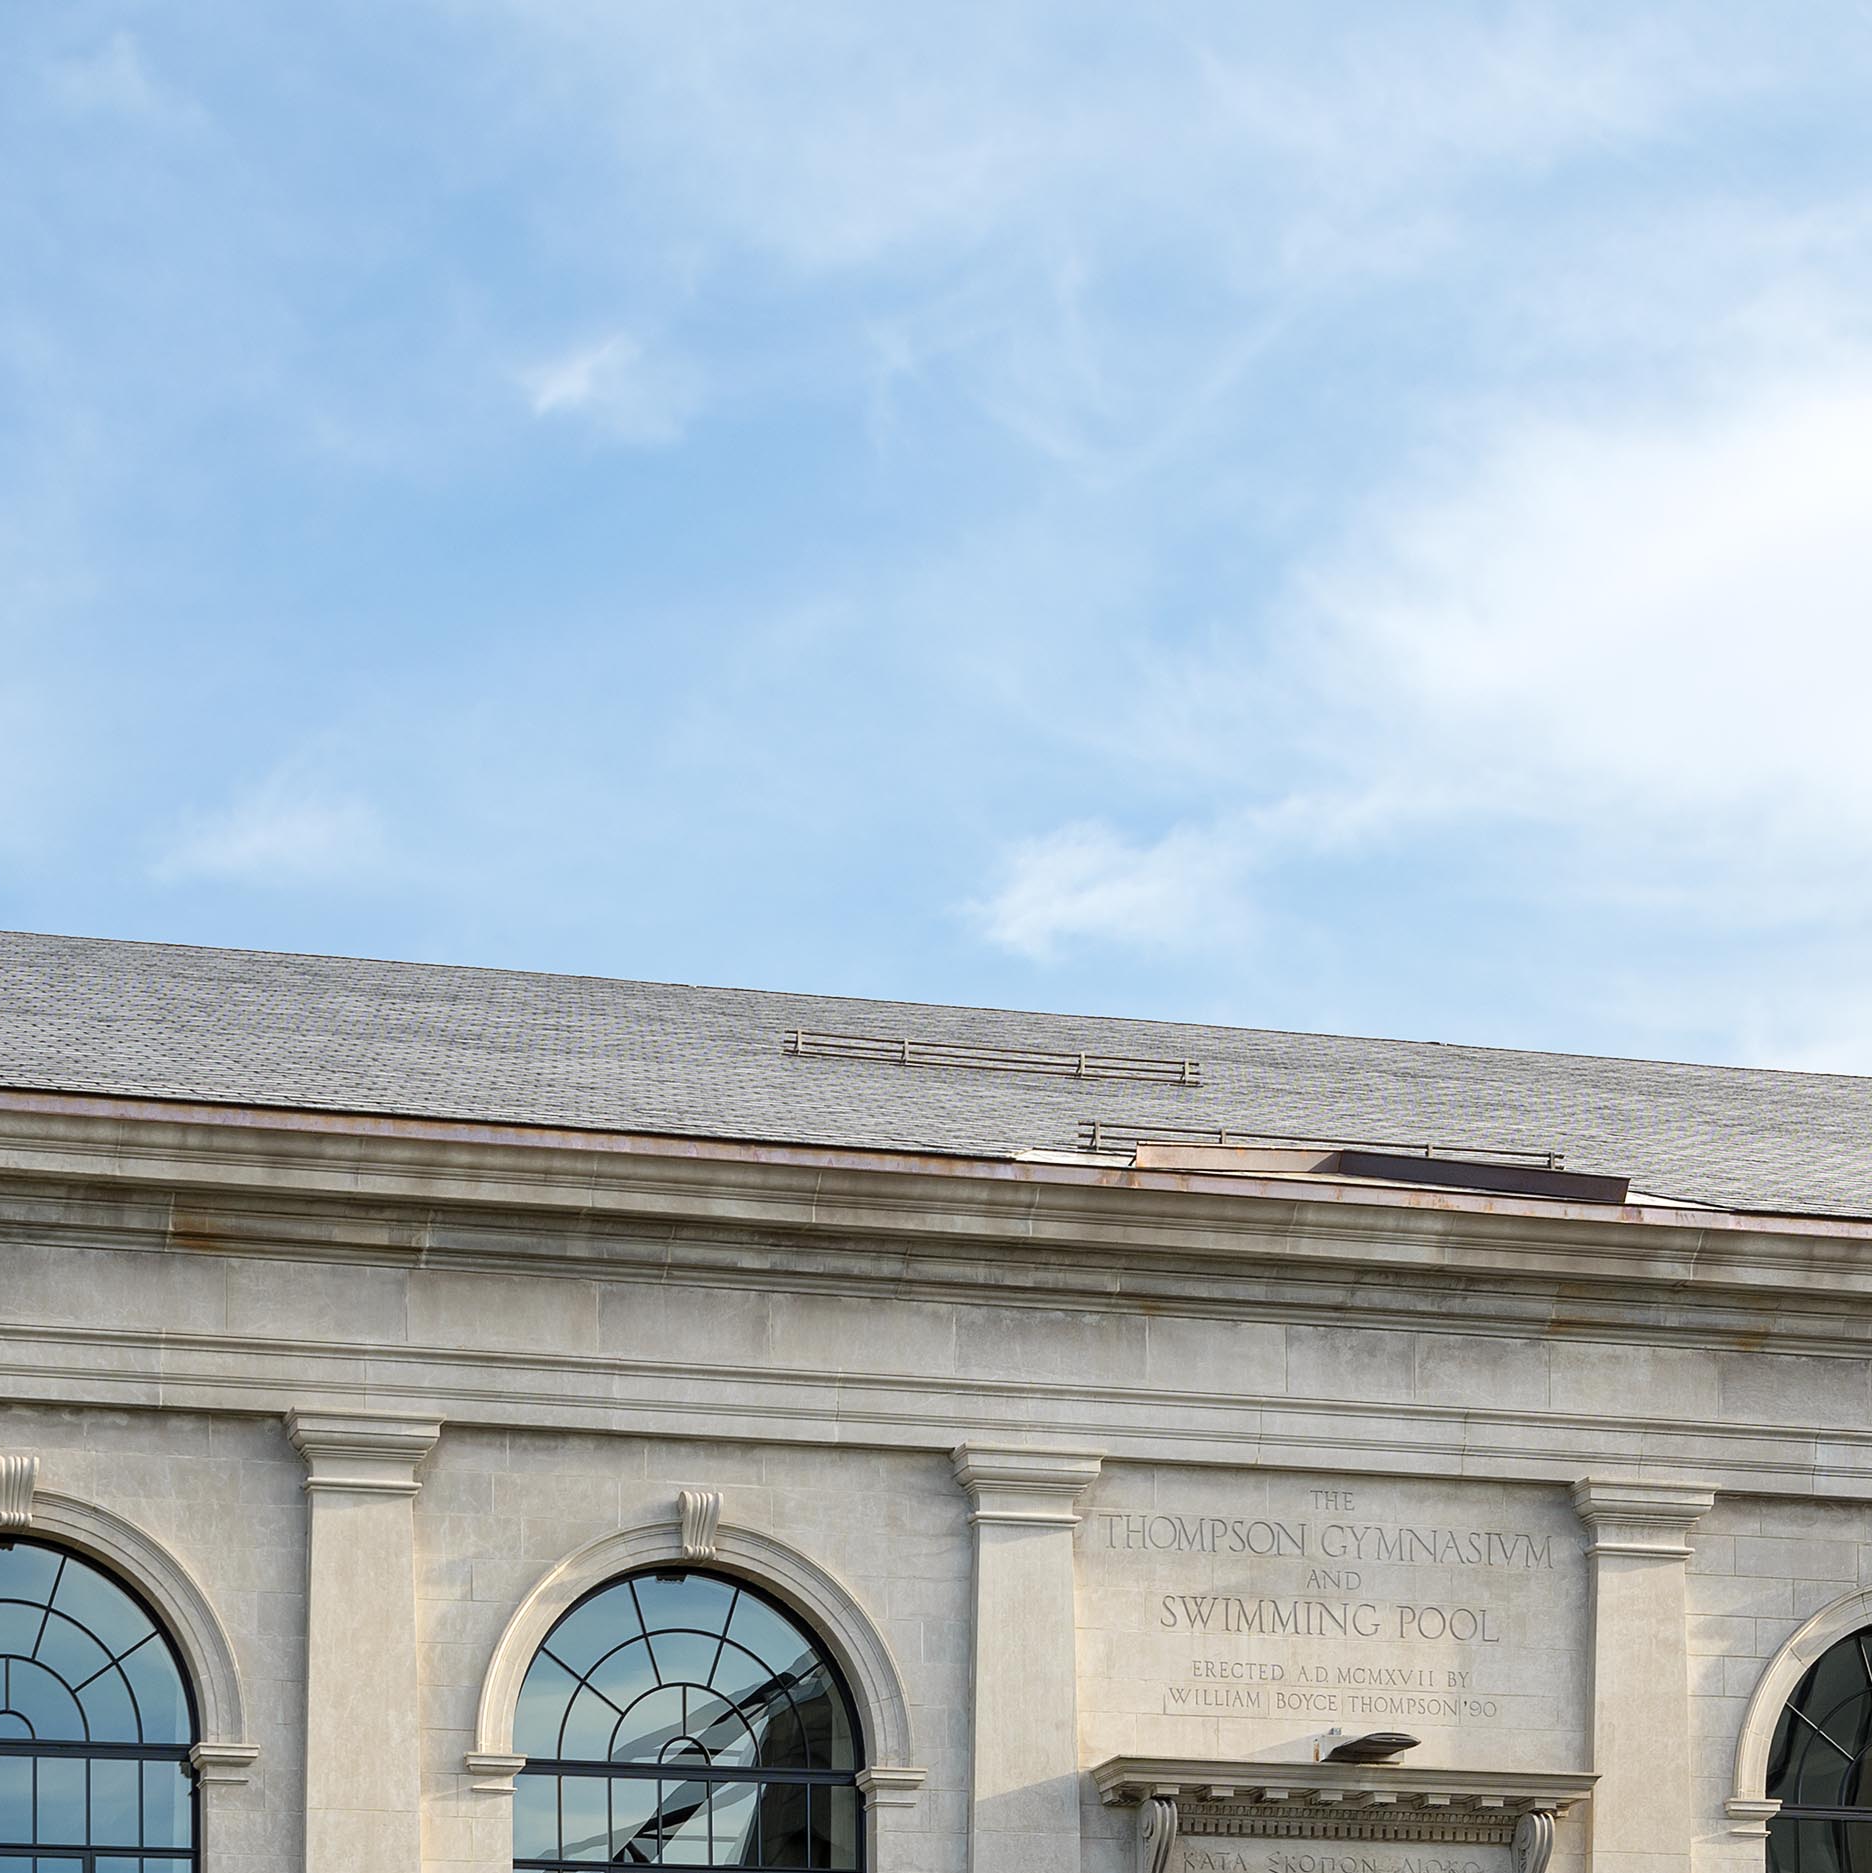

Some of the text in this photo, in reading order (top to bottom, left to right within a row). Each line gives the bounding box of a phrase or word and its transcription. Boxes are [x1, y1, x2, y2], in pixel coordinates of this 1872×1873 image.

[1310, 1489, 1356, 1511] THE
[1098, 1513, 1554, 1569] THOMPSON GYMNASIVM
[1306, 1569, 1362, 1591] AND
[1160, 1594, 1500, 1643] SWIMMING POOL
[1192, 1660, 1285, 1681] ERECTED
[1337, 1666, 1434, 1687] MCMXVII
[1447, 1671, 1470, 1689] BY
[1168, 1687, 1261, 1708] WILLIAM
[1276, 1691, 1338, 1712] BOYCE
[1348, 1695, 1458, 1717] THOMPSON
